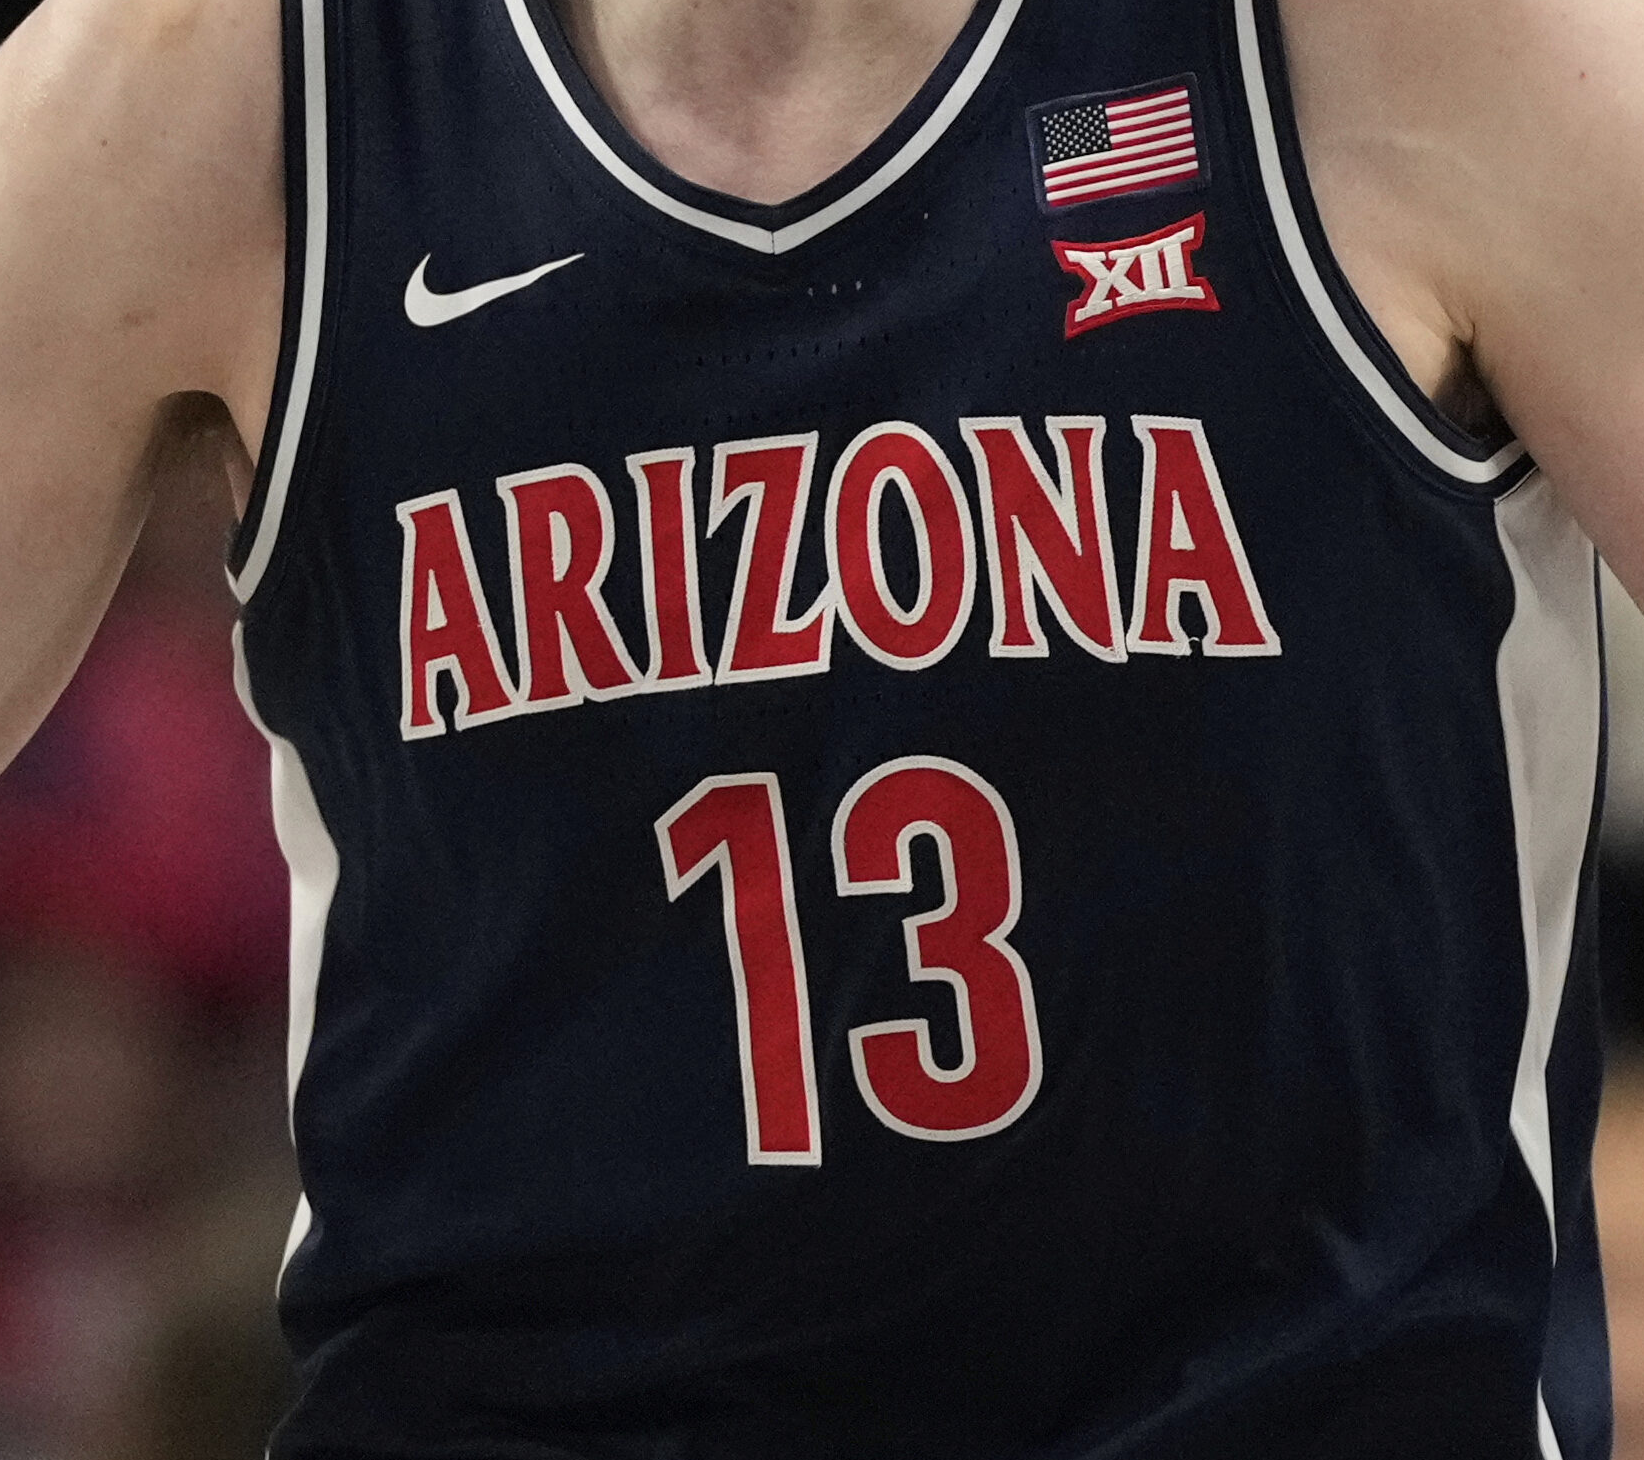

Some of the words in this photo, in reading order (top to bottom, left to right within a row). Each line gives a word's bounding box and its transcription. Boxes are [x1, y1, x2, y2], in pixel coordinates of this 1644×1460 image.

[1064, 226, 1206, 323] XII
[396, 413, 1283, 741] ARIZONA
[653, 754, 1044, 1167] 13
